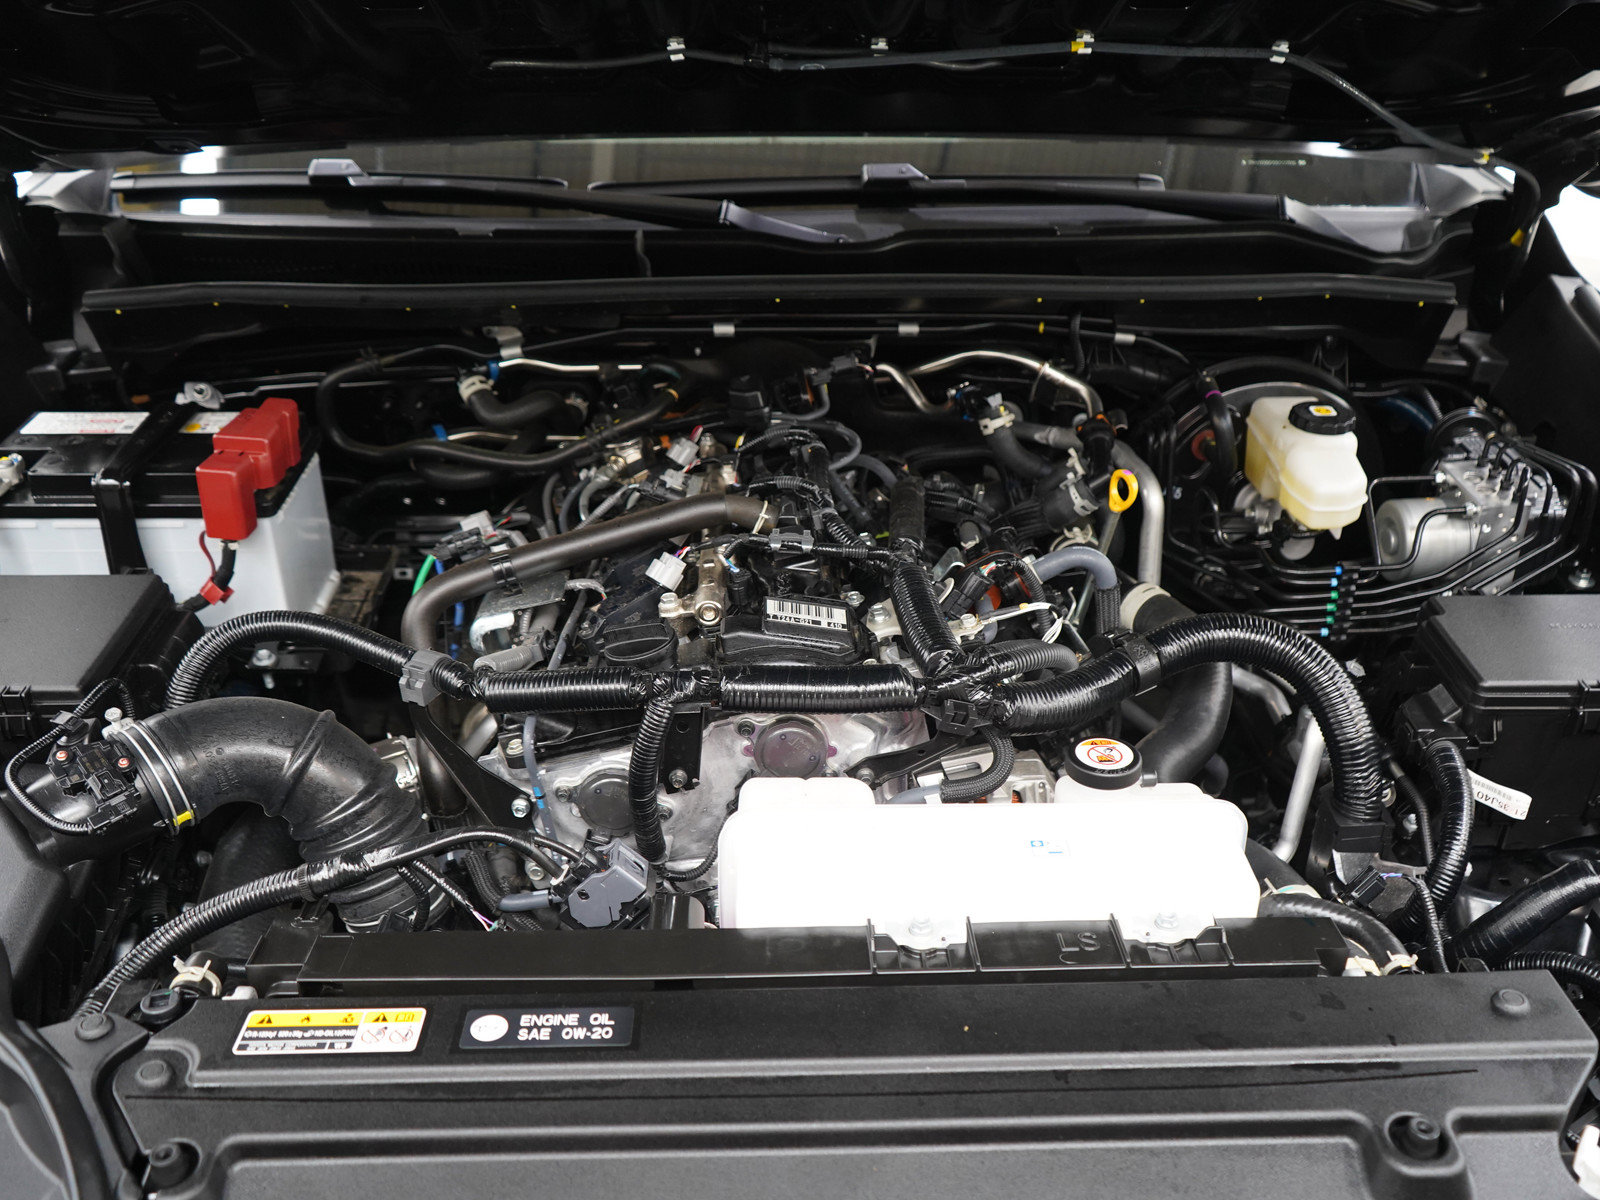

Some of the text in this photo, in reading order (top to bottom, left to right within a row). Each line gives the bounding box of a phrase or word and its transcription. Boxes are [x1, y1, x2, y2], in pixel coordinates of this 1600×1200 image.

[1056, 931, 1101, 952] LS
[519, 1013, 615, 1027] ENGINE OIL
[517, 1027, 551, 1041] SAE
